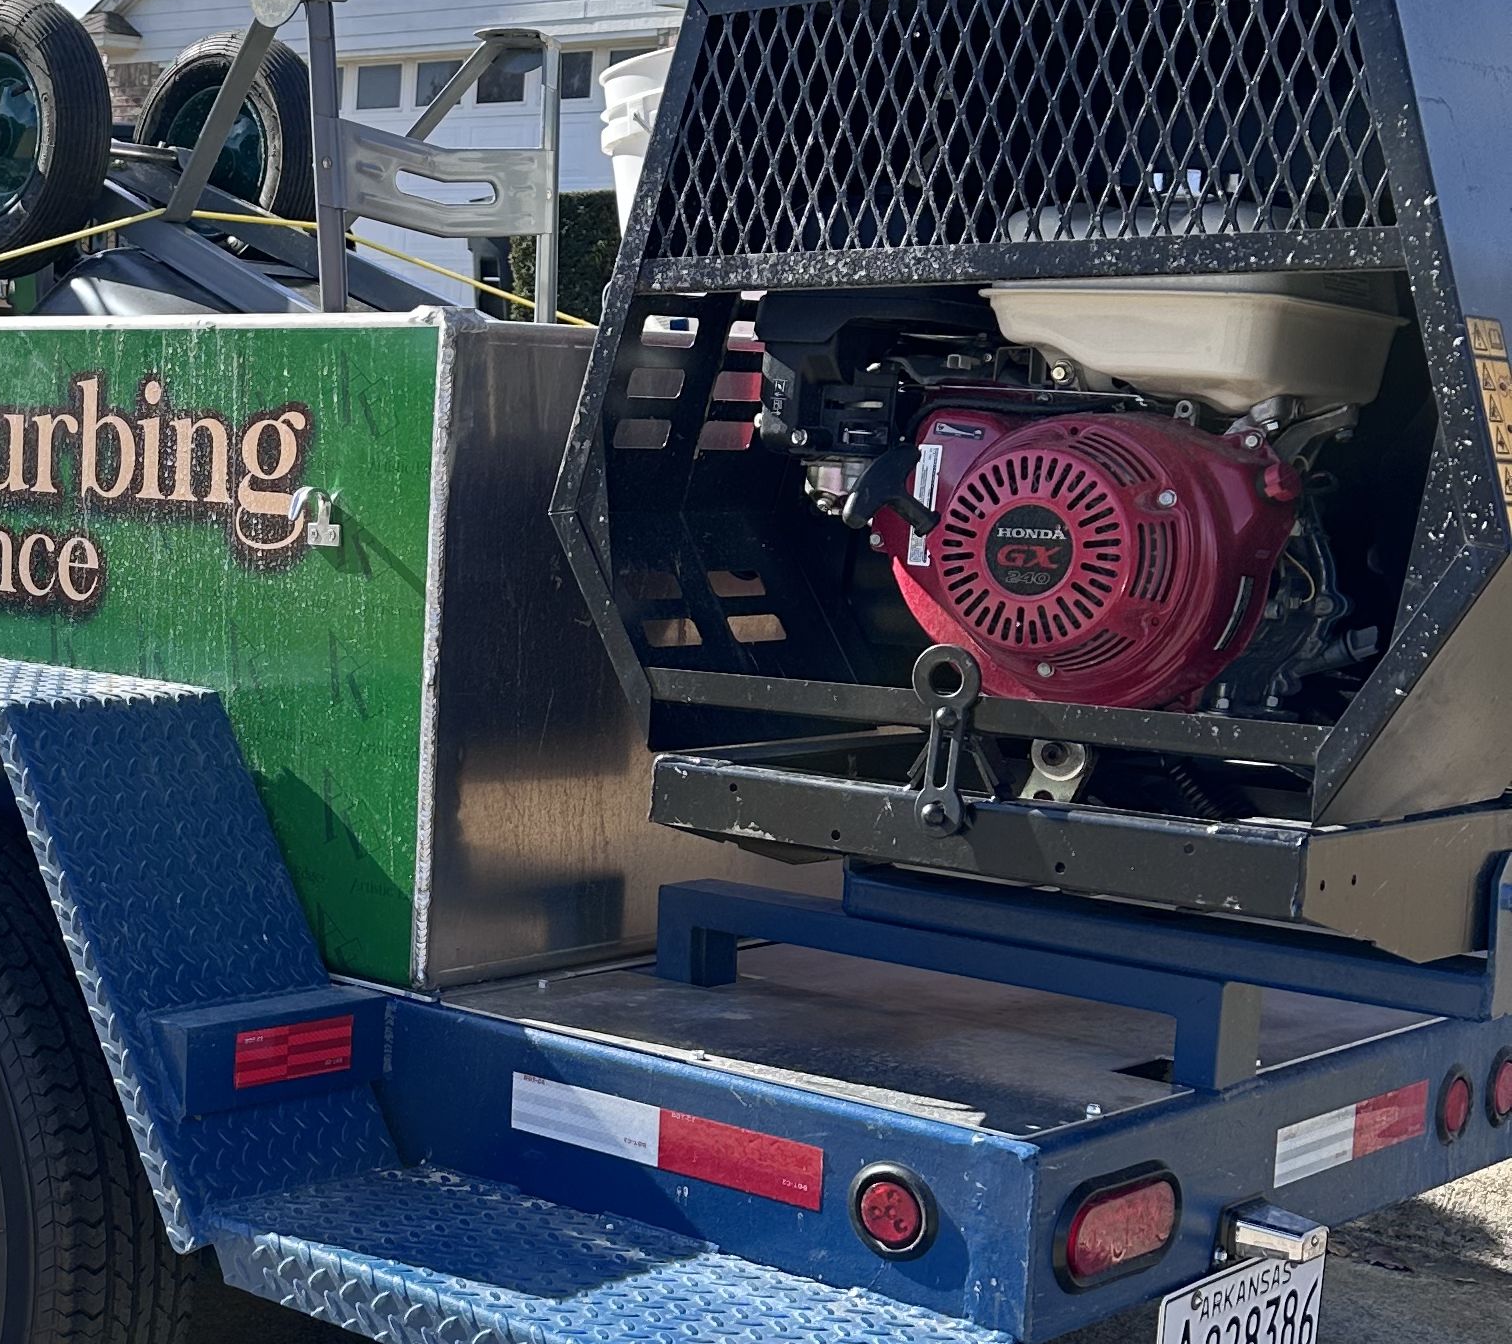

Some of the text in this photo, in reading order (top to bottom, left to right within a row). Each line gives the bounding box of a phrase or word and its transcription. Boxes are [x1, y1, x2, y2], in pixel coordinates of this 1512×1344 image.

[997, 525, 1068, 540] HONDA
[997, 544, 1063, 569] GX
[1005, 571, 1051, 584] 240
[1200, 1261, 1293, 1322] ARKANSAS
